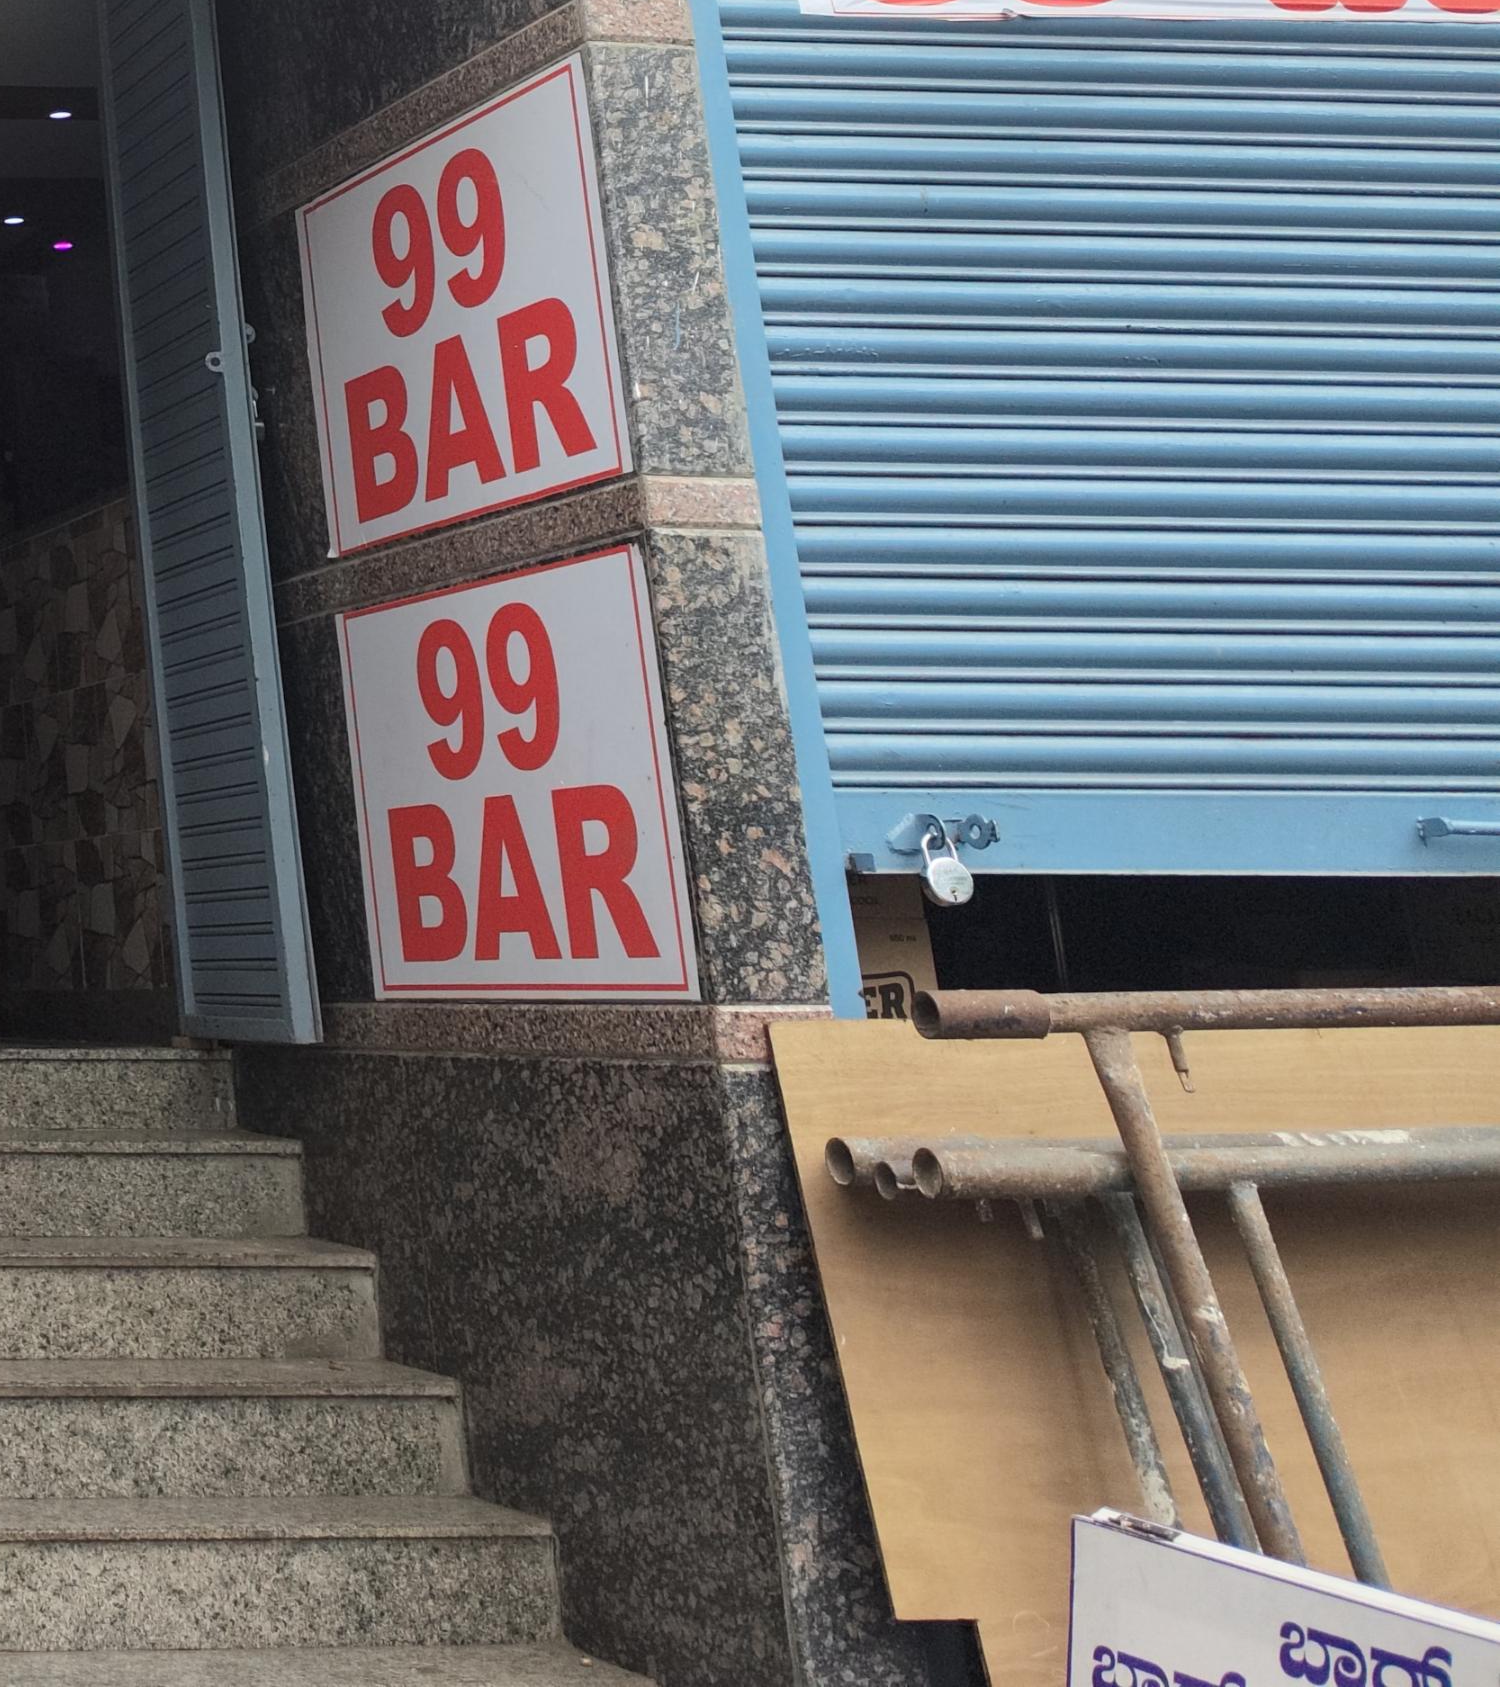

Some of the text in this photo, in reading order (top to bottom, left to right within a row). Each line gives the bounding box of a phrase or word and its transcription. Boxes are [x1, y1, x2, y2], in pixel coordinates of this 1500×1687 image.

[371, 146, 507, 339] 99
[343, 296, 598, 525] BAR
[415, 601, 561, 782] 99
[388, 782, 661, 964] BAR
